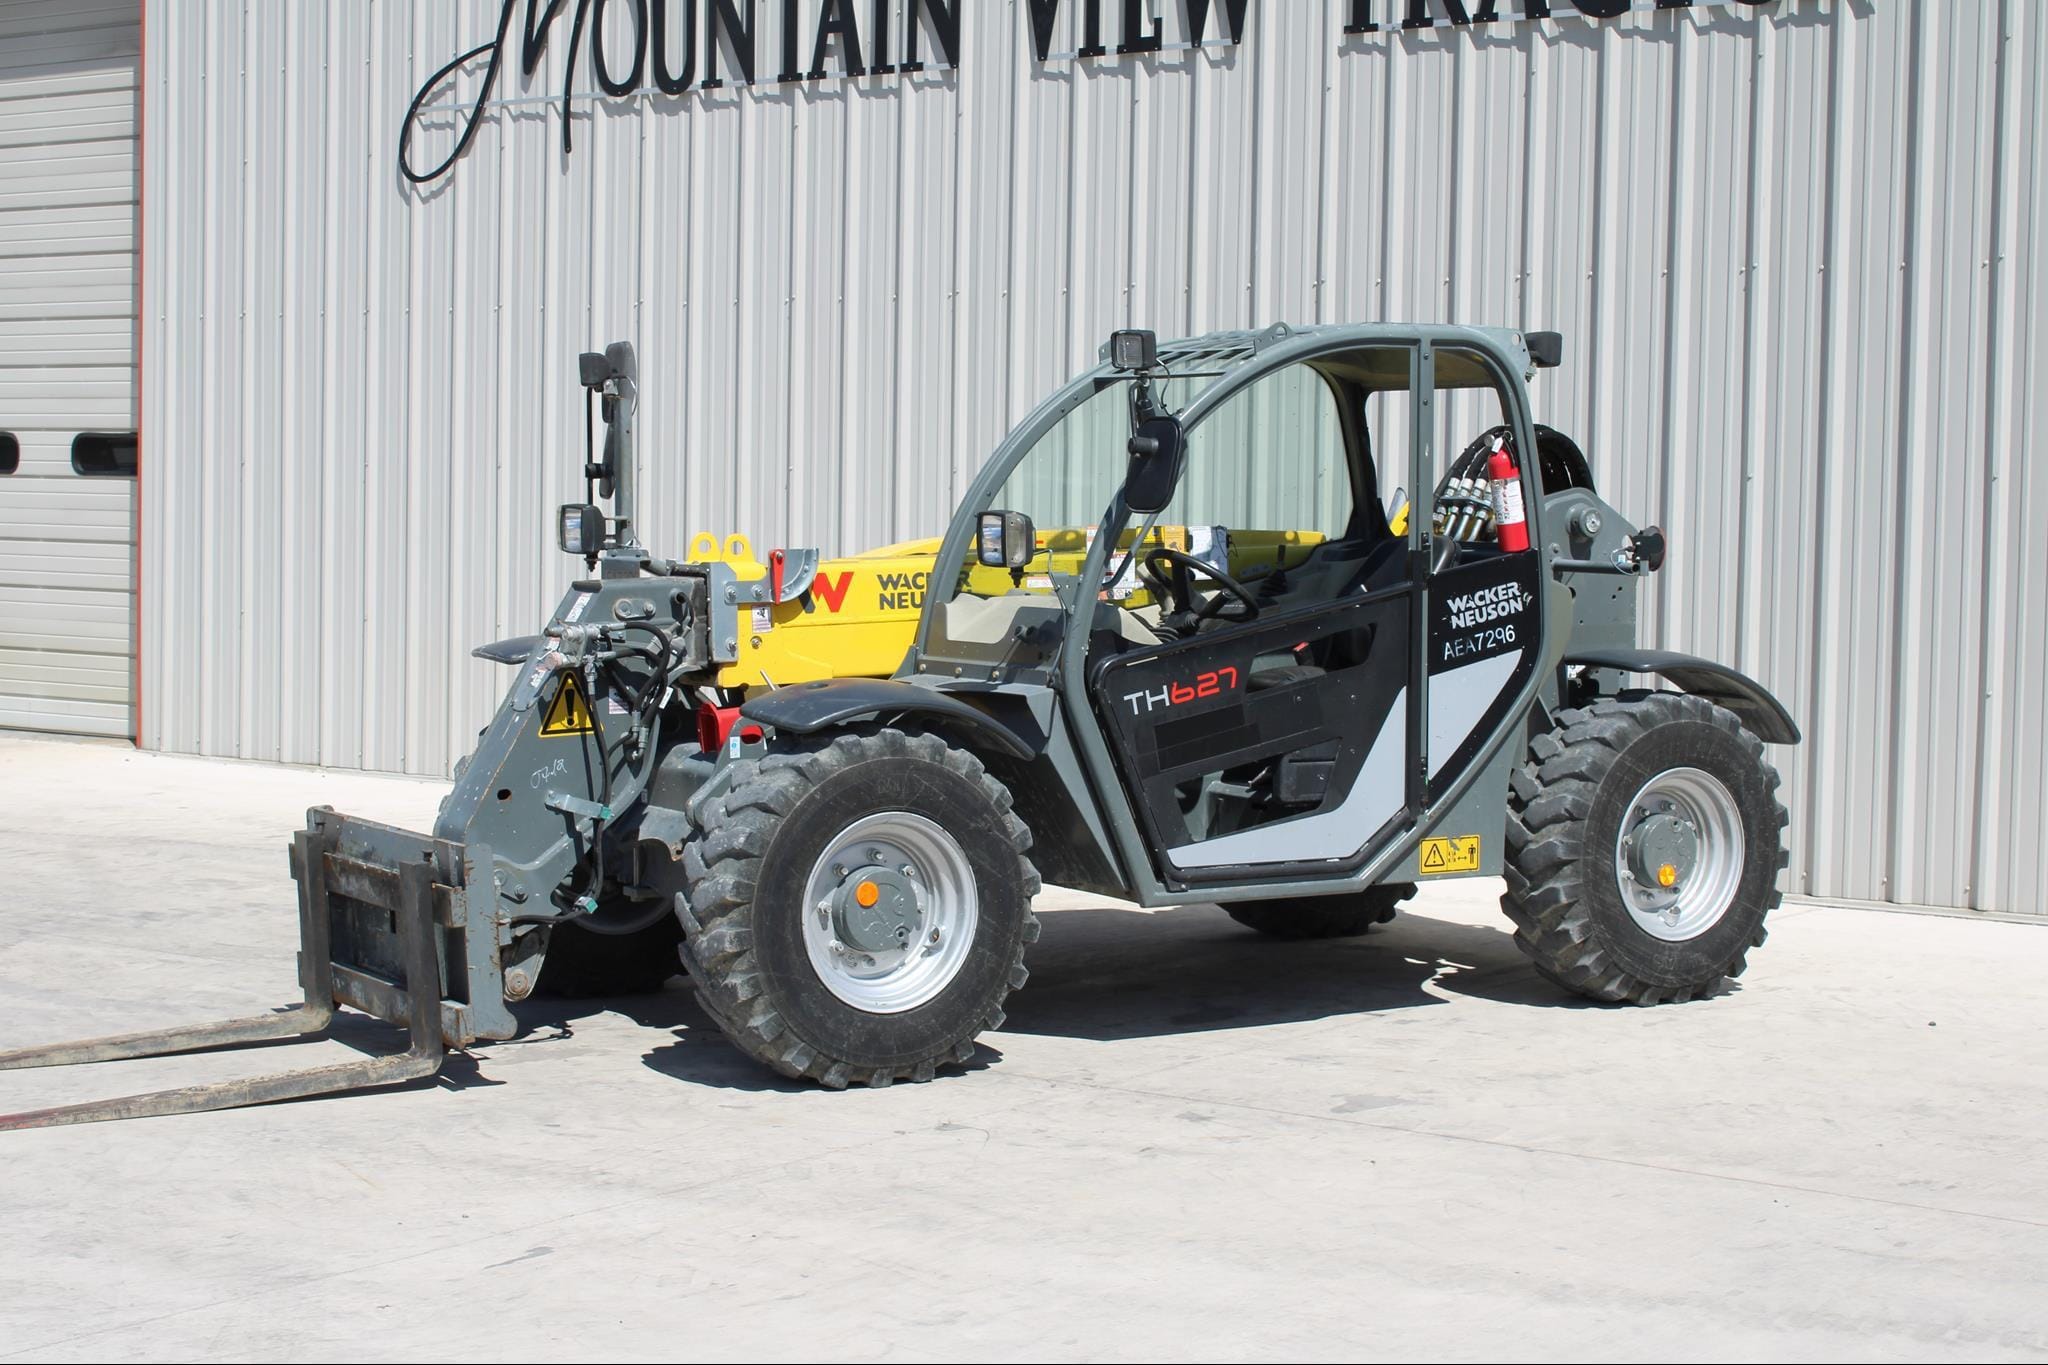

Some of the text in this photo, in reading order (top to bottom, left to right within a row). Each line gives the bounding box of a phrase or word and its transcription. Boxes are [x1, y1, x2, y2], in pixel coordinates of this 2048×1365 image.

[1447, 582, 1521, 613] WACKER
[1450, 597, 1523, 629] NEUSON
[1444, 624, 1516, 661] AEA7296
[1123, 666, 1237, 715] TH627
